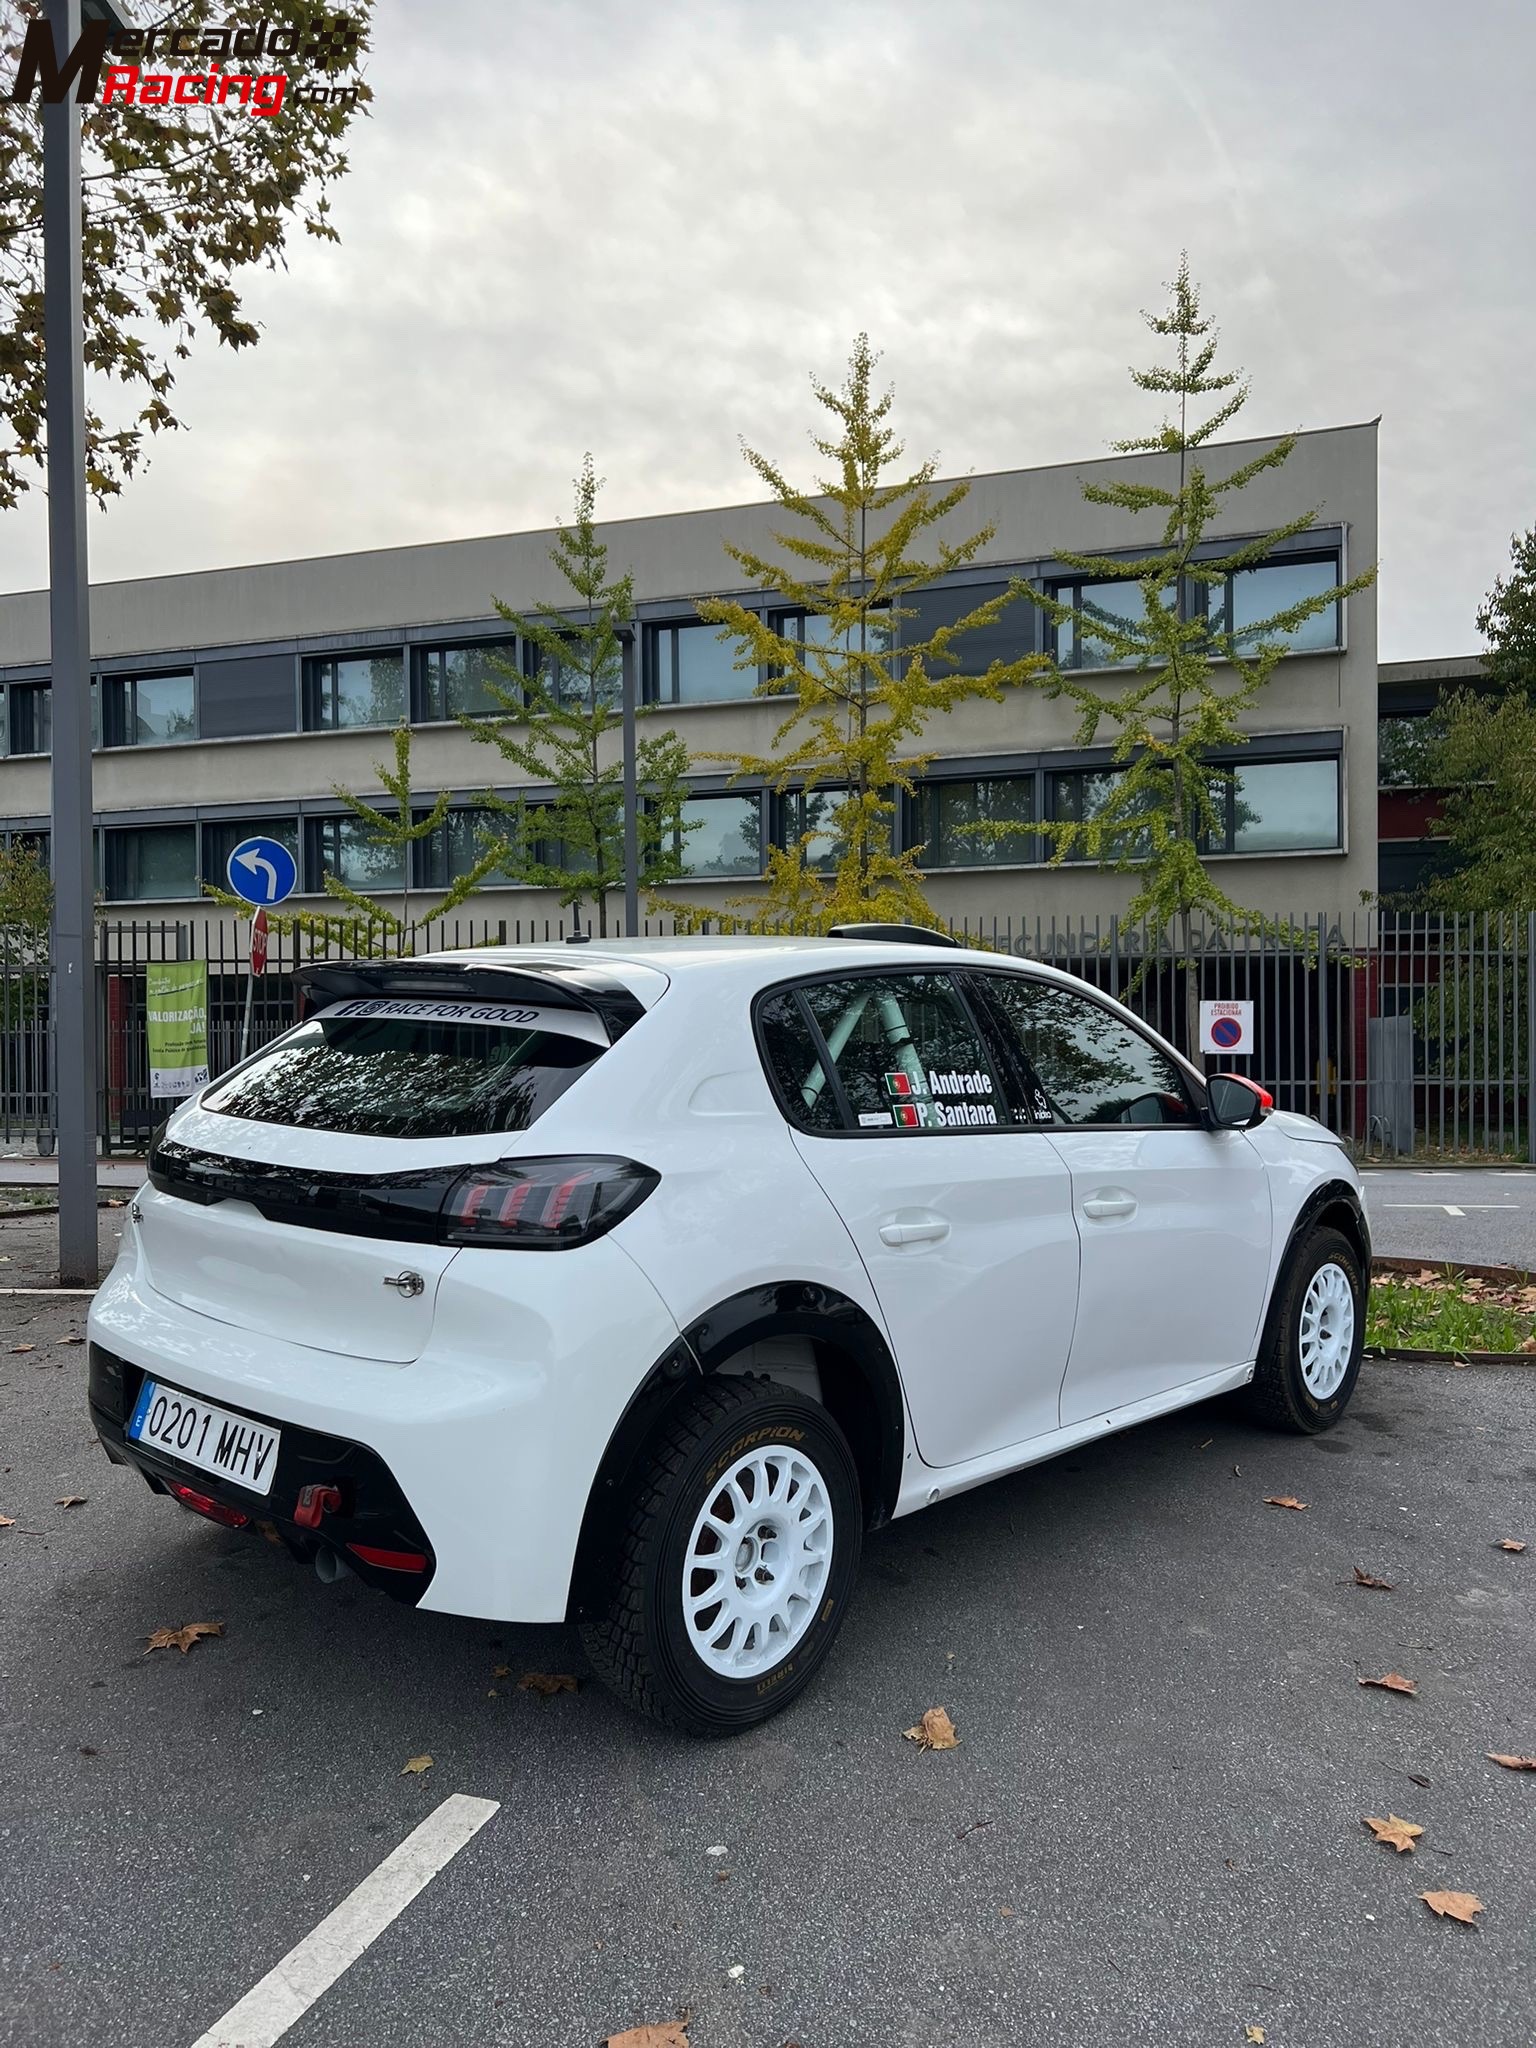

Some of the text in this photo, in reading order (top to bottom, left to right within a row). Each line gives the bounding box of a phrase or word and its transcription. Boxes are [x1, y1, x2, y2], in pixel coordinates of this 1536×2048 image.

[253, 927, 268, 957] STOP
[983, 929, 1173, 956] ECUNDRIA
[379, 1002, 540, 1024] RACE FOR GOOD
[911, 1069, 993, 1096] J. Andrade
[917, 1102, 933, 1127] P.
[934, 1101, 998, 1127] Santana
[135, 1415, 143, 1428] E
[149, 1396, 275, 1481] 0201 MHV
[705, 1426, 806, 1486] SCORPION
